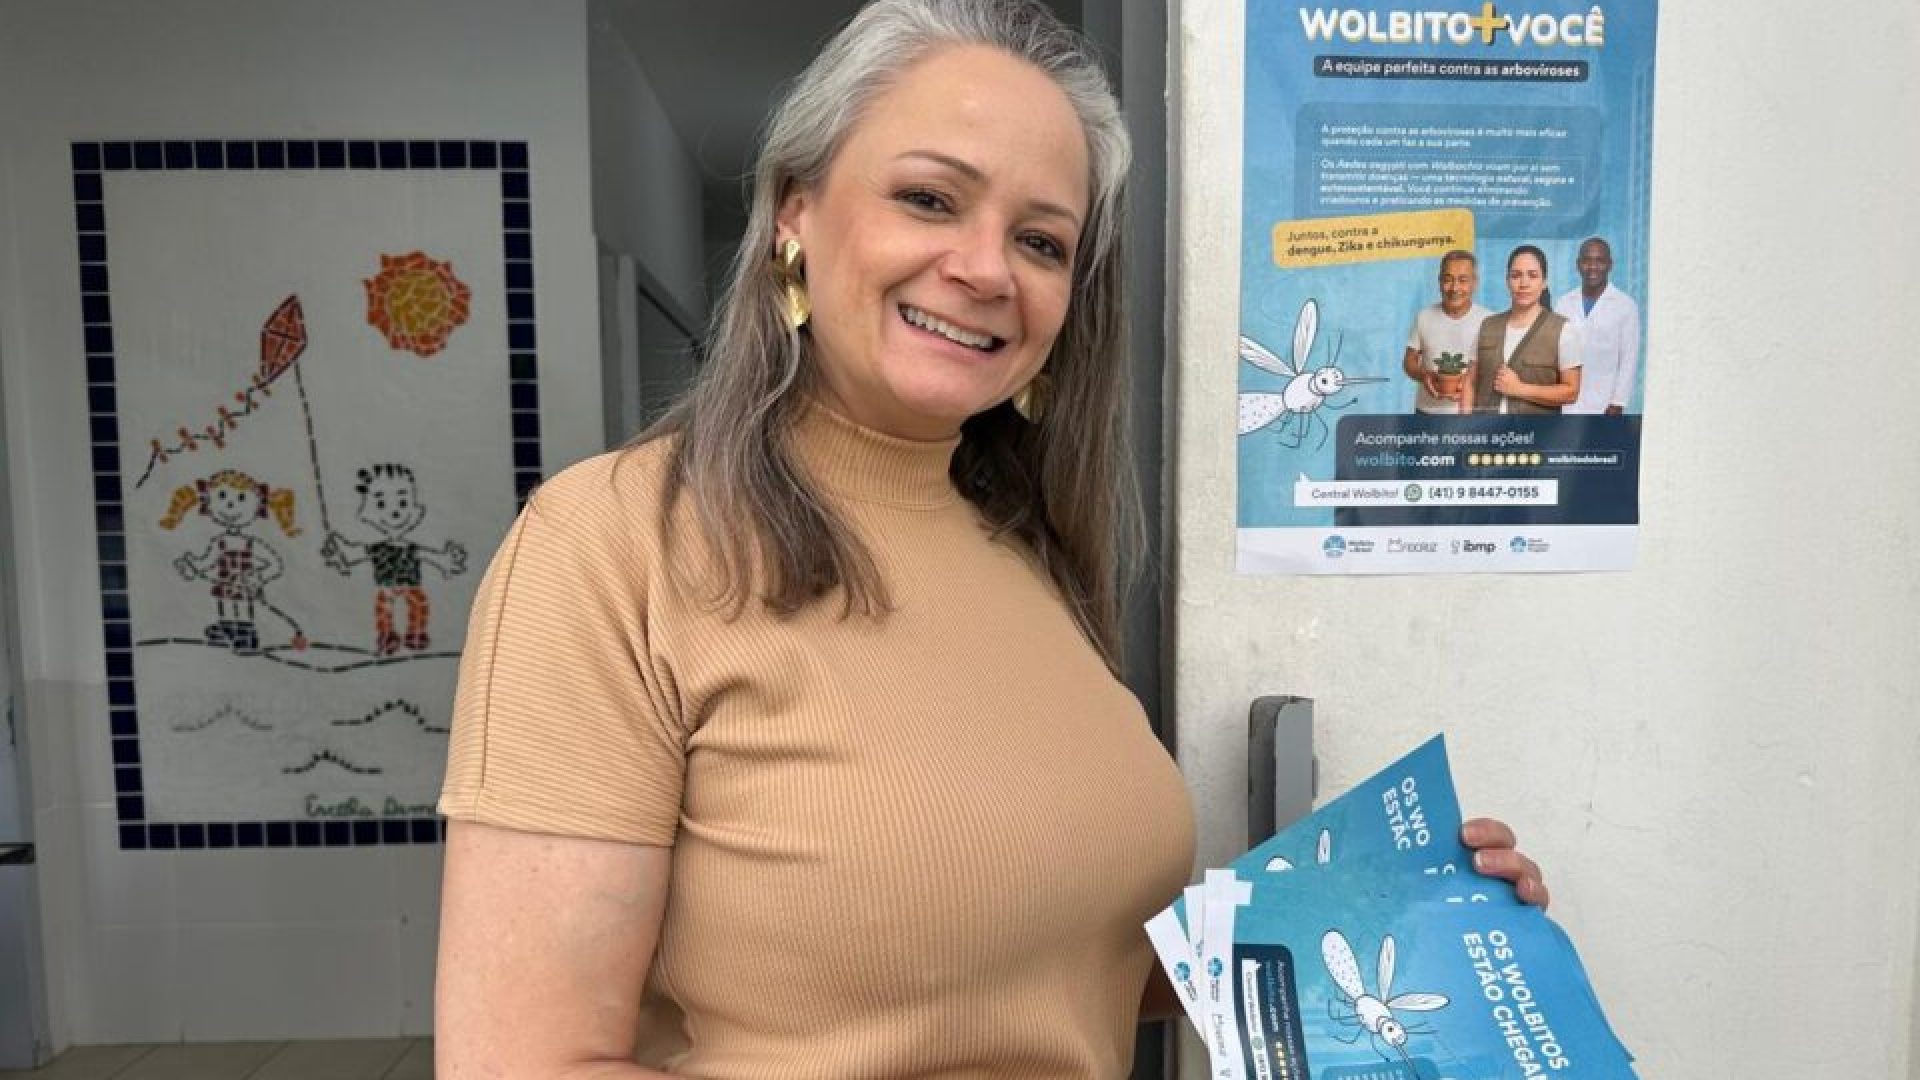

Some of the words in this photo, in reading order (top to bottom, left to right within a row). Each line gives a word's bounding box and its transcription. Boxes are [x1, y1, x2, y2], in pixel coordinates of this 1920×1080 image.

[1321, 59, 1333, 72] A
[1336, 61, 1381, 77] equipe
[1384, 61, 1436, 77] perfeita
[1439, 63, 1481, 76] contra
[1484, 65, 1499, 76] as
[1501, 63, 1580, 78] arboviroses
[1287, 231, 1329, 243] Juntos,
[1331, 227, 1369, 240] contra
[1371, 227, 1379, 236] a
[1287, 244, 1337, 257] dengue,
[1337, 240, 1363, 253] Zika
[1365, 242, 1375, 250] e
[1375, 234, 1458, 249] chikungunya.
[1355, 431, 1439, 447] Acompanhe
[1441, 433, 1489, 445] nossas
[1491, 431, 1535, 446] ações!
[1355, 451, 1455, 467] wolbito.com
[1311, 487, 1351, 500] Central
[1353, 487, 1399, 500] Wolbito!
[1429, 485, 1455, 500] (41)
[1456, 486, 1466, 499] 9
[1468, 486, 1540, 500] 8447-0155
[1401, 777, 1419, 807] OS
[1409, 805, 1430, 847] WO
[1462, 933, 1505, 1002] ESTÃO
[1487, 929, 1514, 961] OS
[1501, 962, 1571, 1070] WOLBITOS
